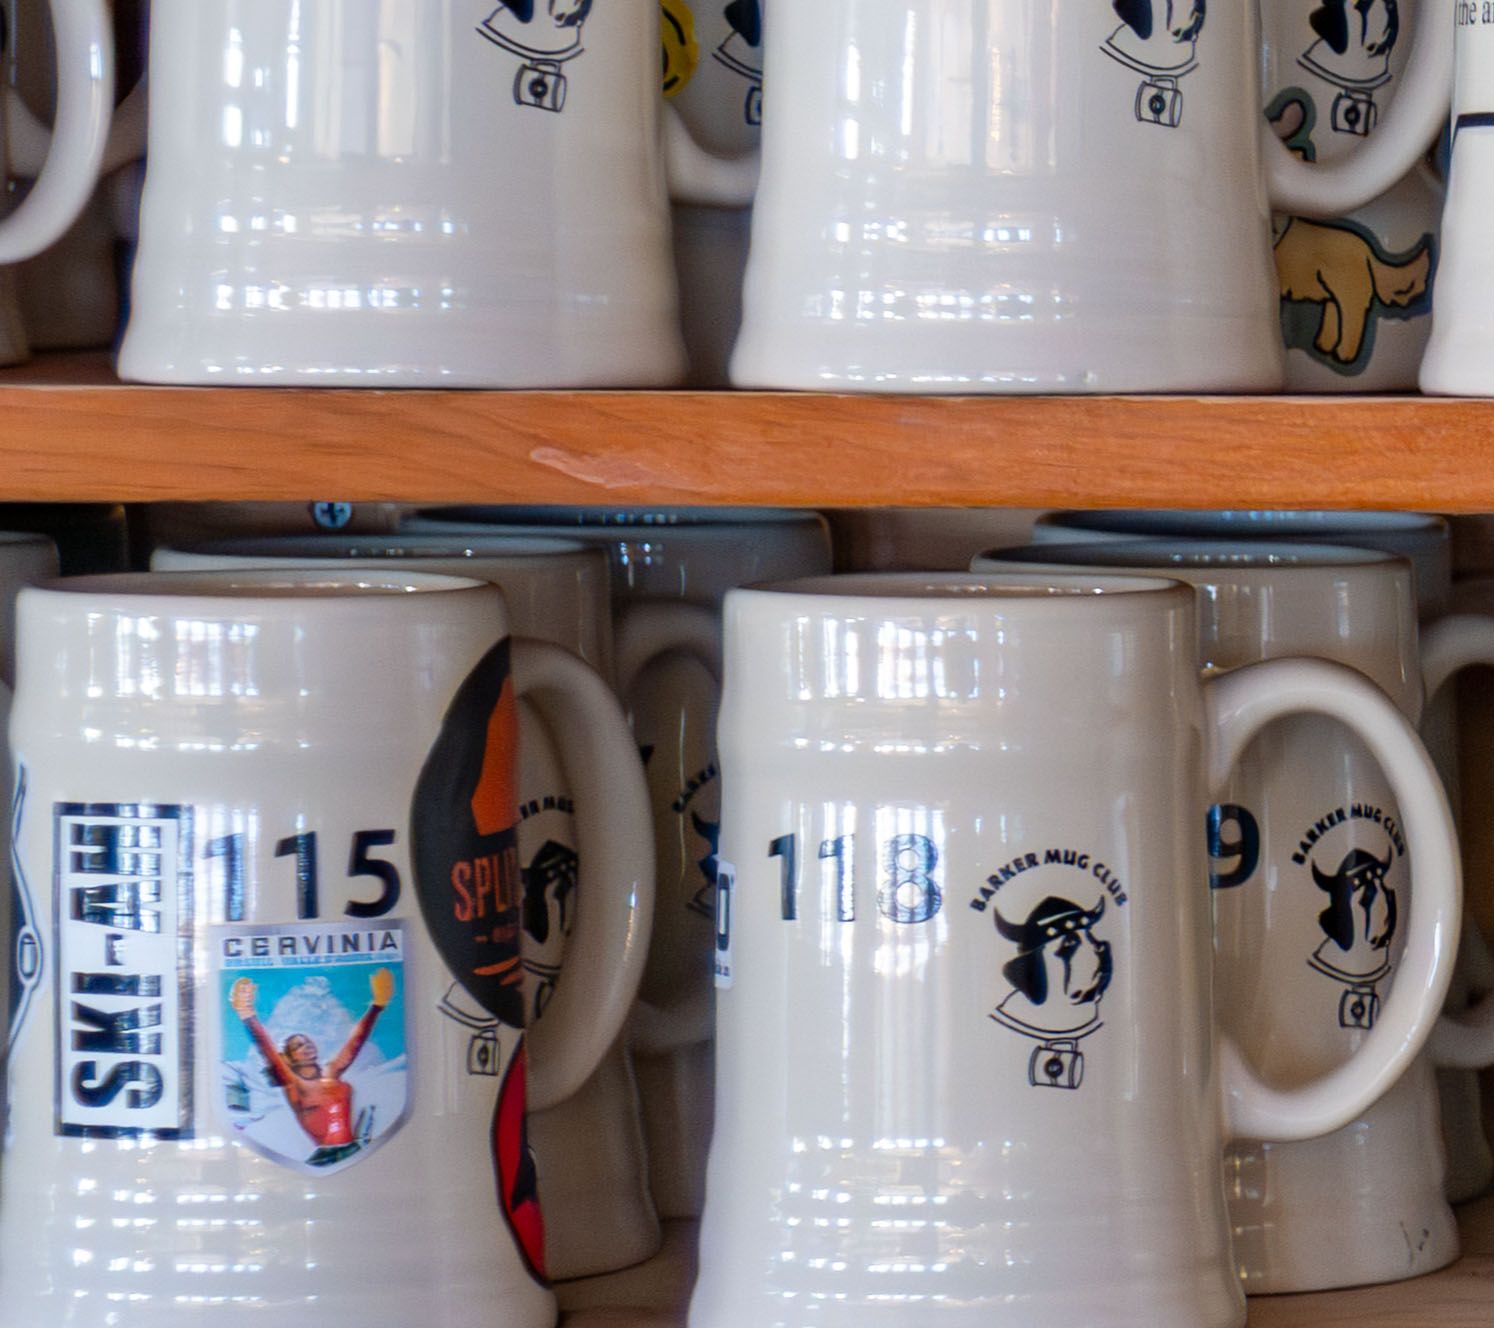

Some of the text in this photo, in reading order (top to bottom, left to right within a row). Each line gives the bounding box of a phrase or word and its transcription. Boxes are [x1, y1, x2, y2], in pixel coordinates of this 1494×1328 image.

[201, 829, 400, 922] 115
[767, 832, 944, 925] 118
[969, 848, 1128, 912] BARKER MUG CLUB
[72, 824, 164, 1110] SKI-AH
[222, 929, 400, 958] CERVINIA
